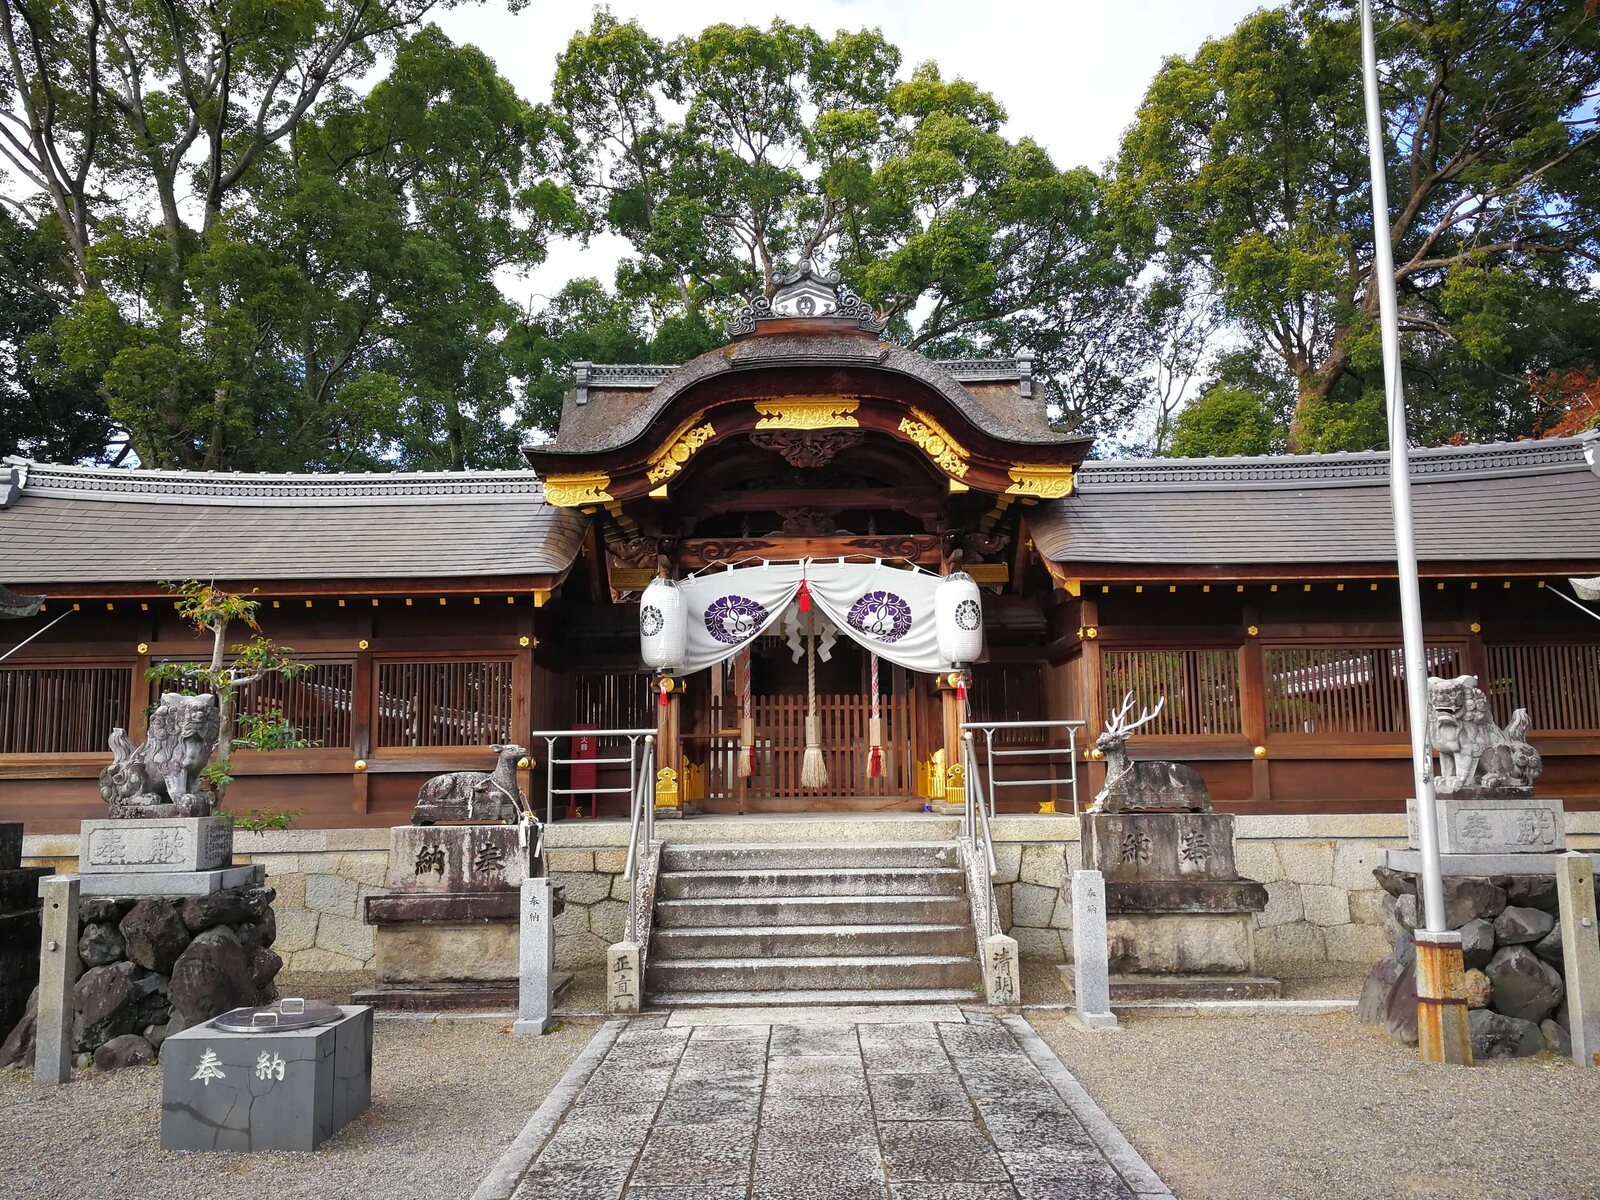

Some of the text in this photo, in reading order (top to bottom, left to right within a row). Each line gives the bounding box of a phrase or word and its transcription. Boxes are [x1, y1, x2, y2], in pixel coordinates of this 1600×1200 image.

[529, 895, 540, 922] 奉納
[993, 947, 1013, 995] 清明
[189, 1047, 286, 1086] 奉納
